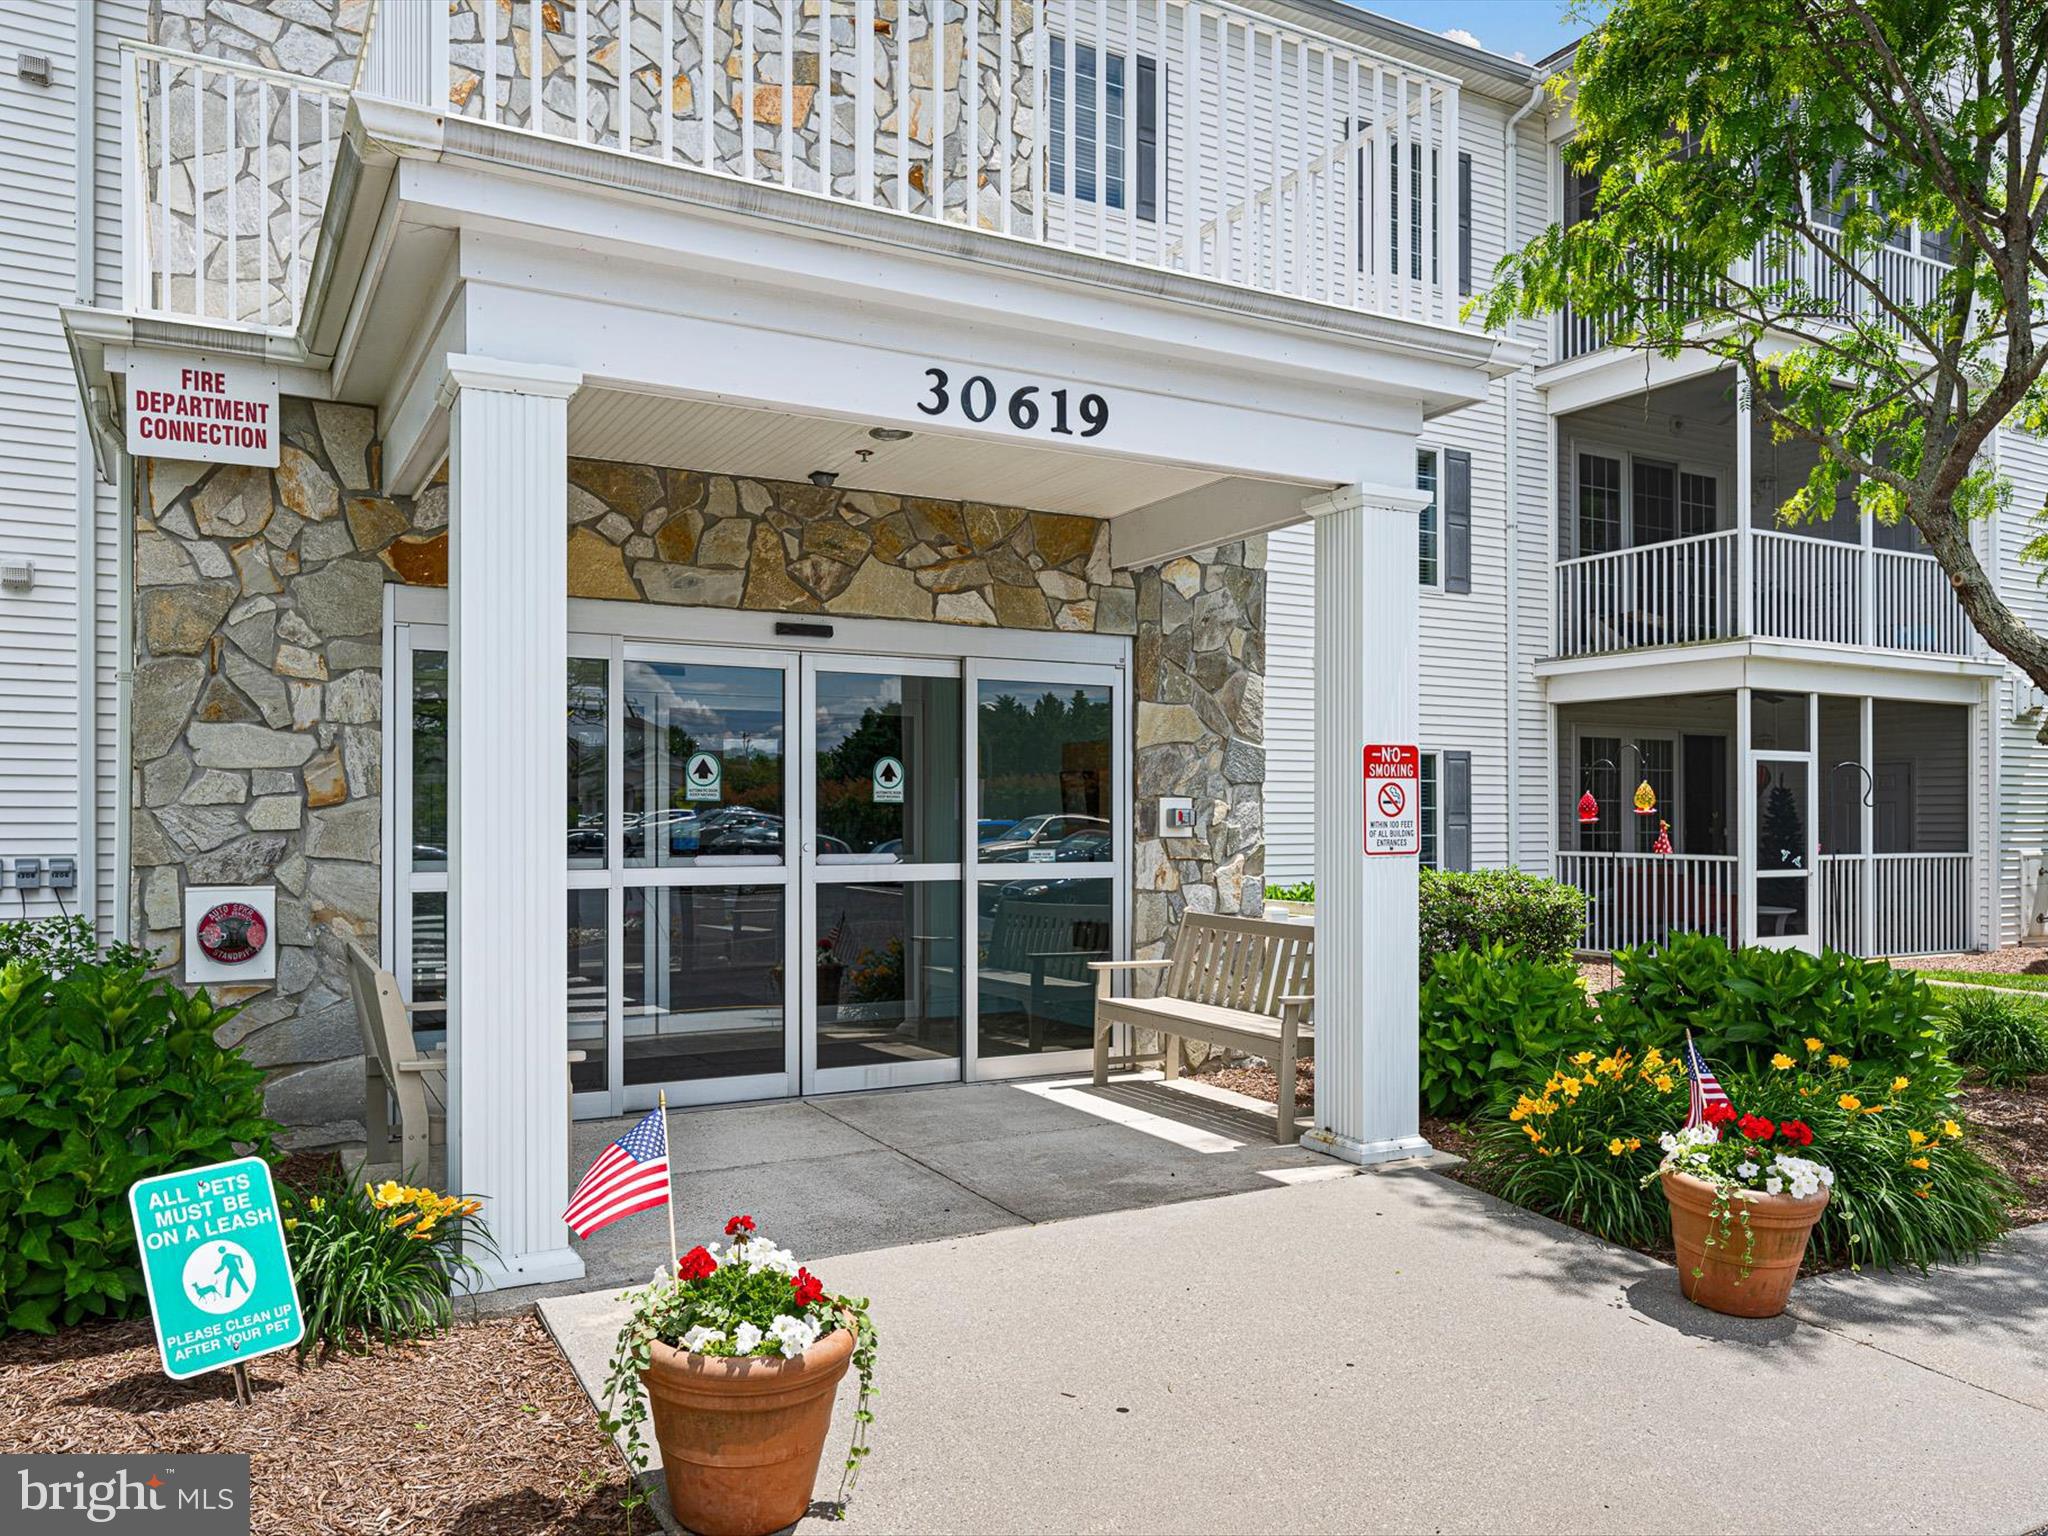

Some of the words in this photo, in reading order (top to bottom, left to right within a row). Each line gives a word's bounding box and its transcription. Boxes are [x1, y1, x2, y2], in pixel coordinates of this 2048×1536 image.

[181, 368, 226, 394] FIRE
[136, 390, 269, 424] DEPARTMENT
[917, 368, 1109, 437] 30619
[139, 416, 267, 449] CONNECTION
[1381, 746, 1401, 763] NO
[1369, 763, 1414, 777] SMOKING
[1369, 829, 1377, 838] OF
[1378, 829, 1388, 838] ALL
[1389, 829, 1414, 838] BUILDING
[1400, 820, 1413, 828] FEET
[1376, 839, 1407, 847] ENTRANCES
[208, 905, 229, 920] AUTO
[232, 904, 255, 918] SPKR
[213, 946, 258, 960] STANDPIP
[149, 1188, 190, 1211] ALL
[198, 1173, 250, 1199] PETS
[155, 1201, 214, 1228] MUST
[222, 1192, 252, 1213] BE
[146, 1229, 179, 1250] ON
[185, 1225, 200, 1242] A
[204, 1206, 273, 1237] LEASH
[167, 1324, 223, 1349] PLEASE
[225, 1309, 271, 1332] CLEAN
[274, 1303, 292, 1317] UP
[175, 1339, 221, 1362] AFTER
[223, 1328, 262, 1347] YOUR
[265, 1318, 291, 1335] PET
